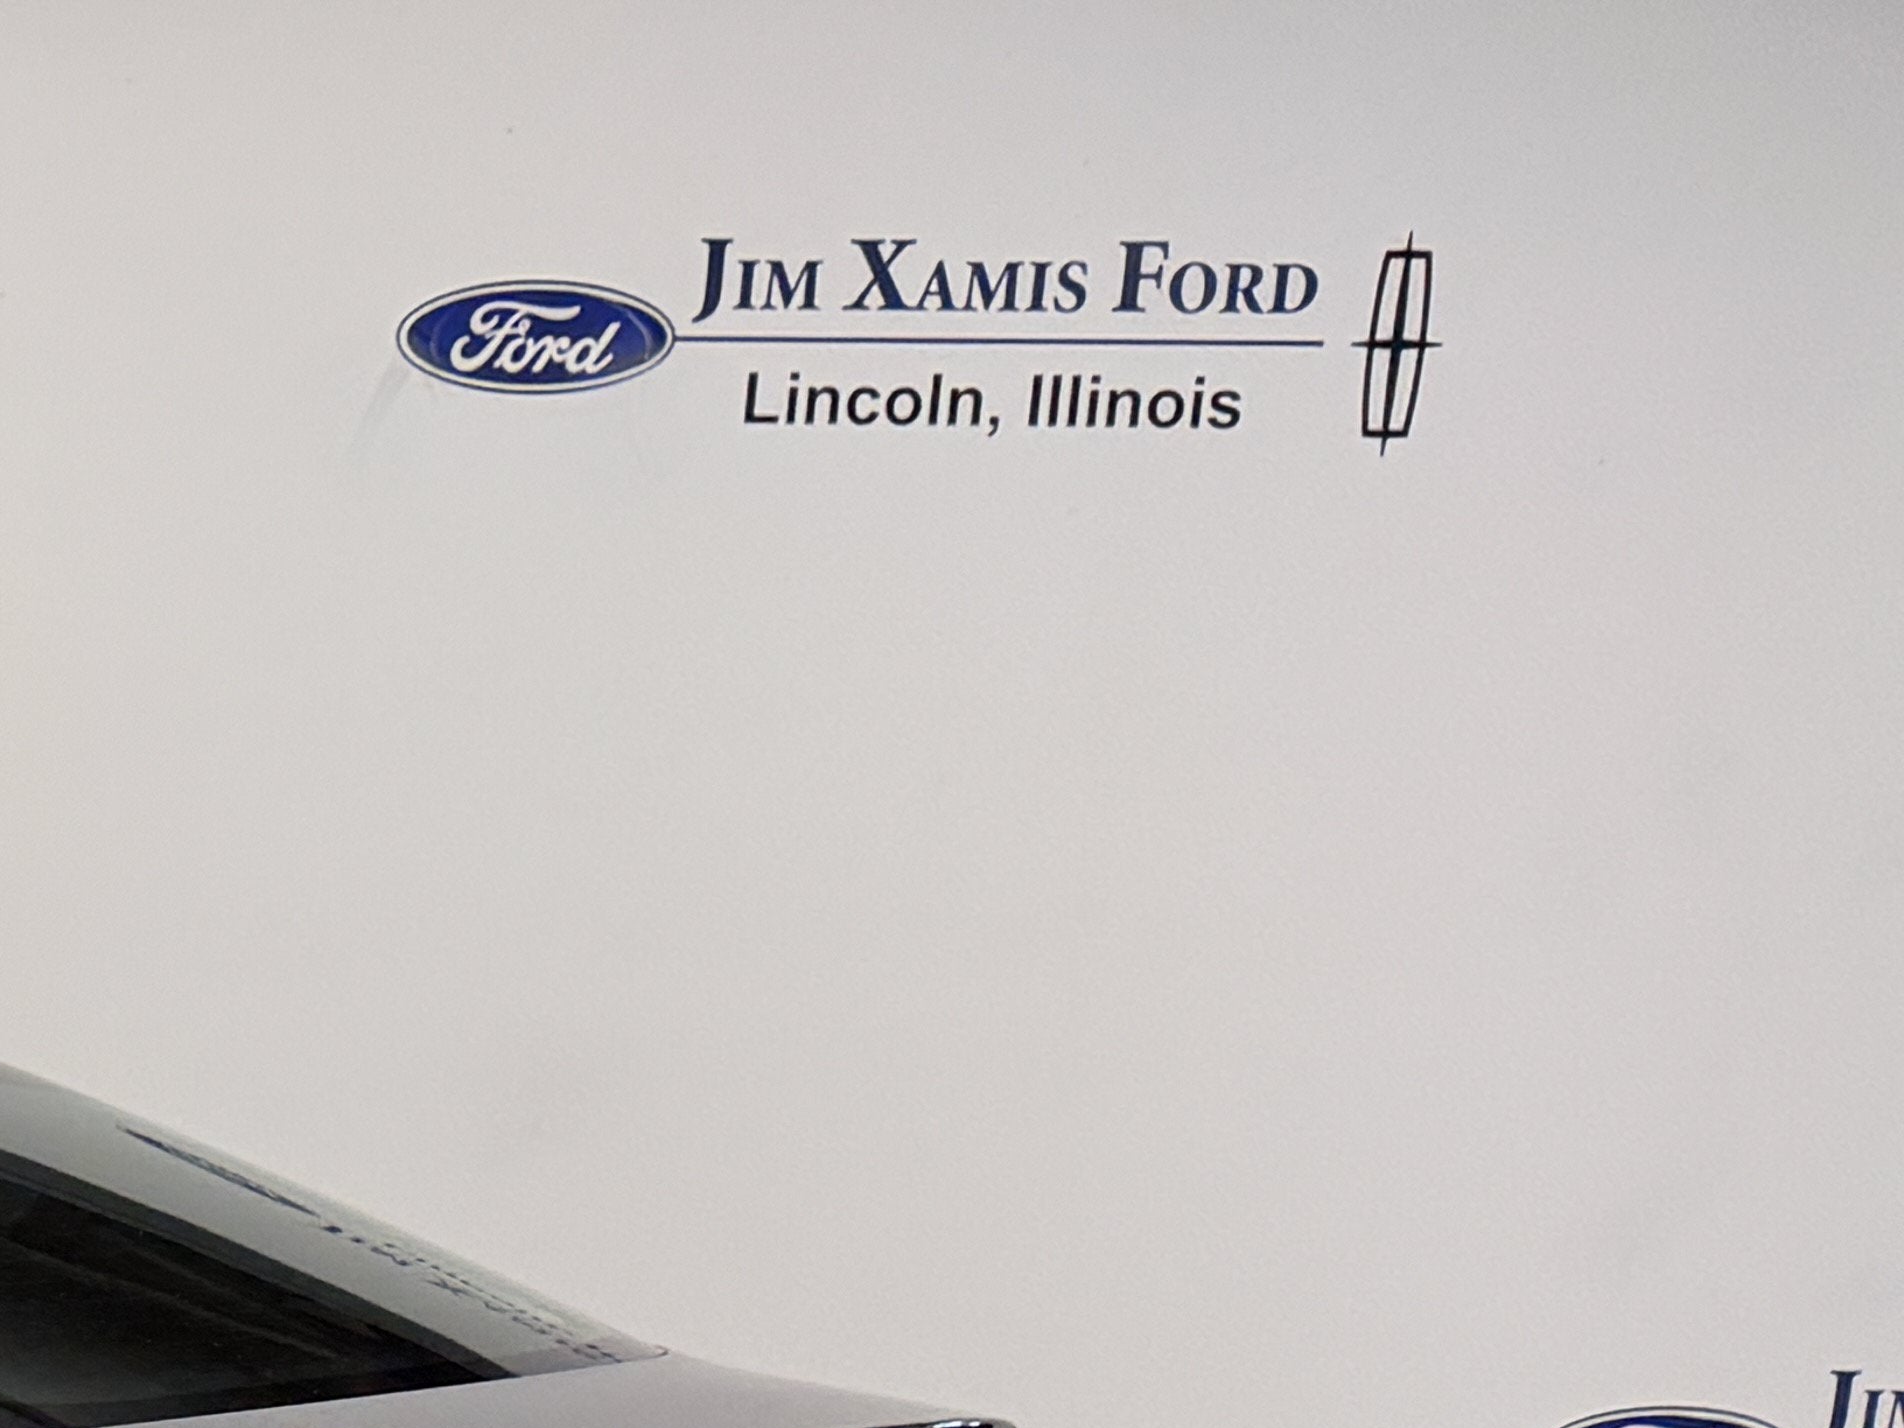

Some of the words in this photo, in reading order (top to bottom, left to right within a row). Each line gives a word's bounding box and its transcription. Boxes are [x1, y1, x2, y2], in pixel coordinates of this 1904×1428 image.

[691, 237, 824, 323] JIM
[846, 238, 1089, 314] XAMIS
[1111, 240, 1319, 315] FORD
[450, 300, 614, 375] Ford
[743, 372, 1001, 437] Lincoln,
[1027, 374, 1242, 431] Illinois
